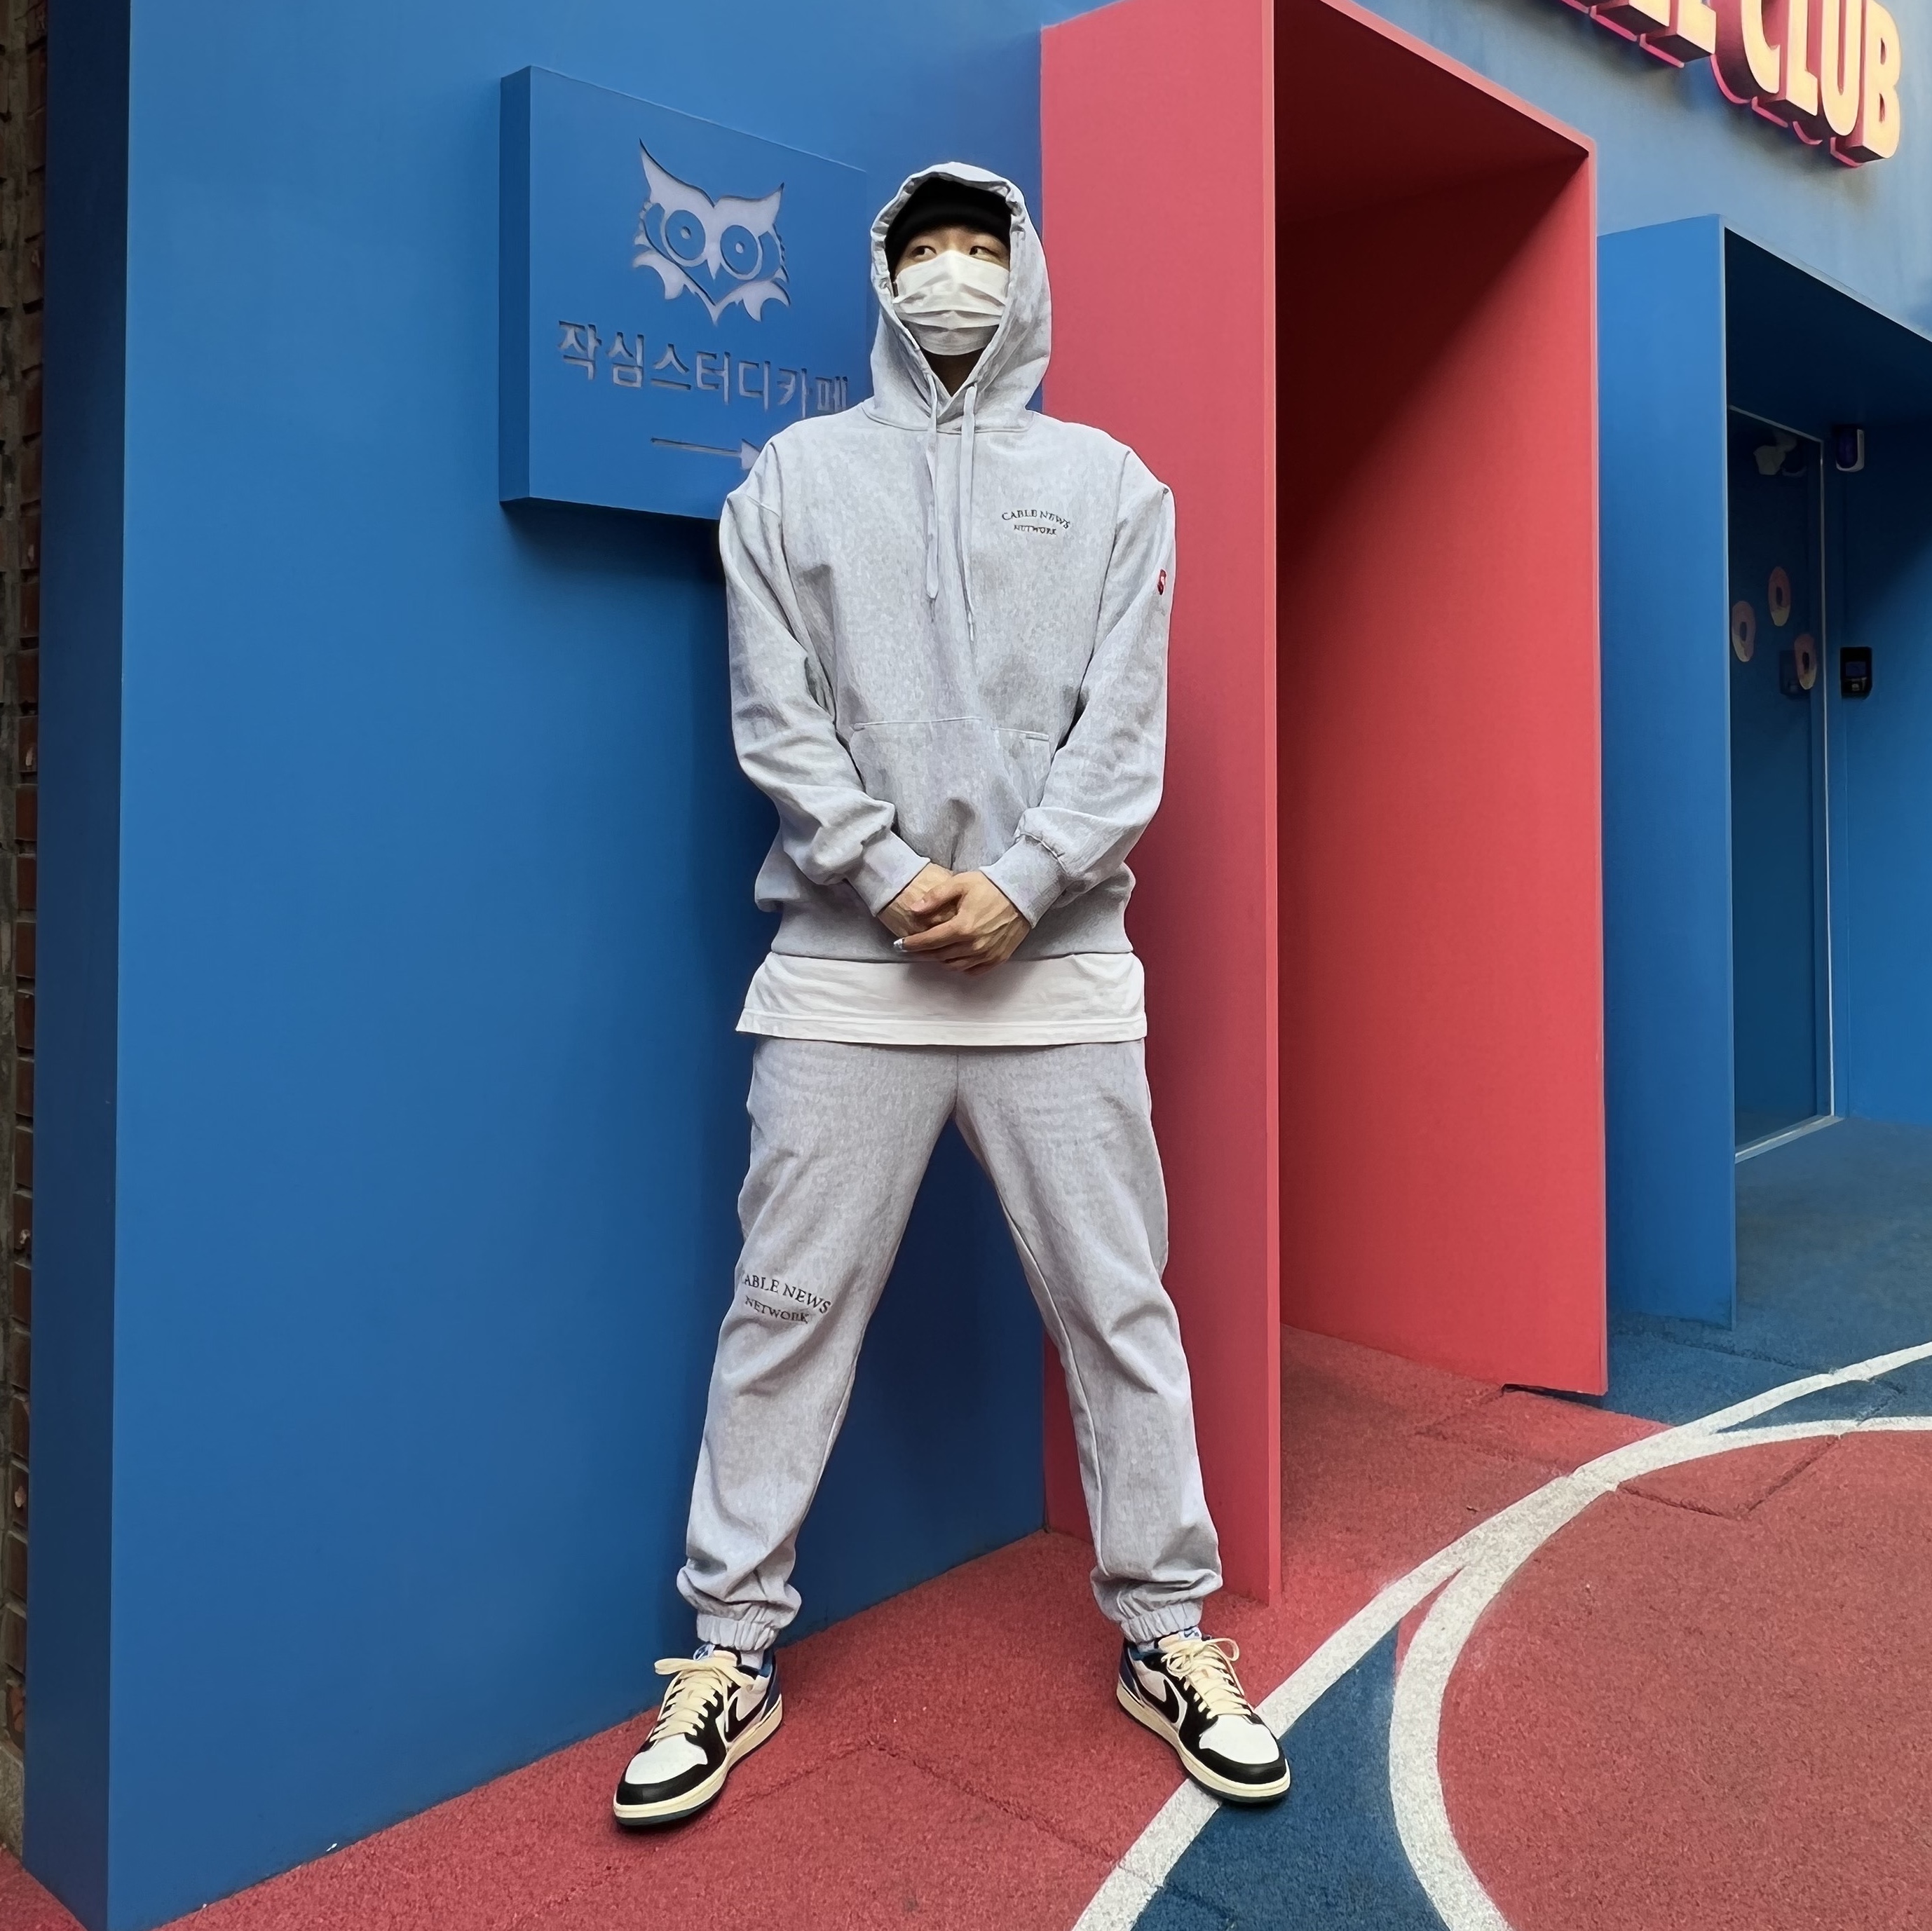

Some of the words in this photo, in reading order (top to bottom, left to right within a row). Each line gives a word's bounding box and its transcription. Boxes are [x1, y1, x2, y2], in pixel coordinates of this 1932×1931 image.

[1741, 0, 1902, 159] CLUB
[558, 320, 848, 418] 작심스터디카페
[1002, 510, 1038, 521] CABLE
[1040, 510, 1070, 529] NEWS
[743, 1274, 780, 1293] ABLE
[782, 1283, 831, 1314] NEWS
[744, 1295, 809, 1324] NETWORK
